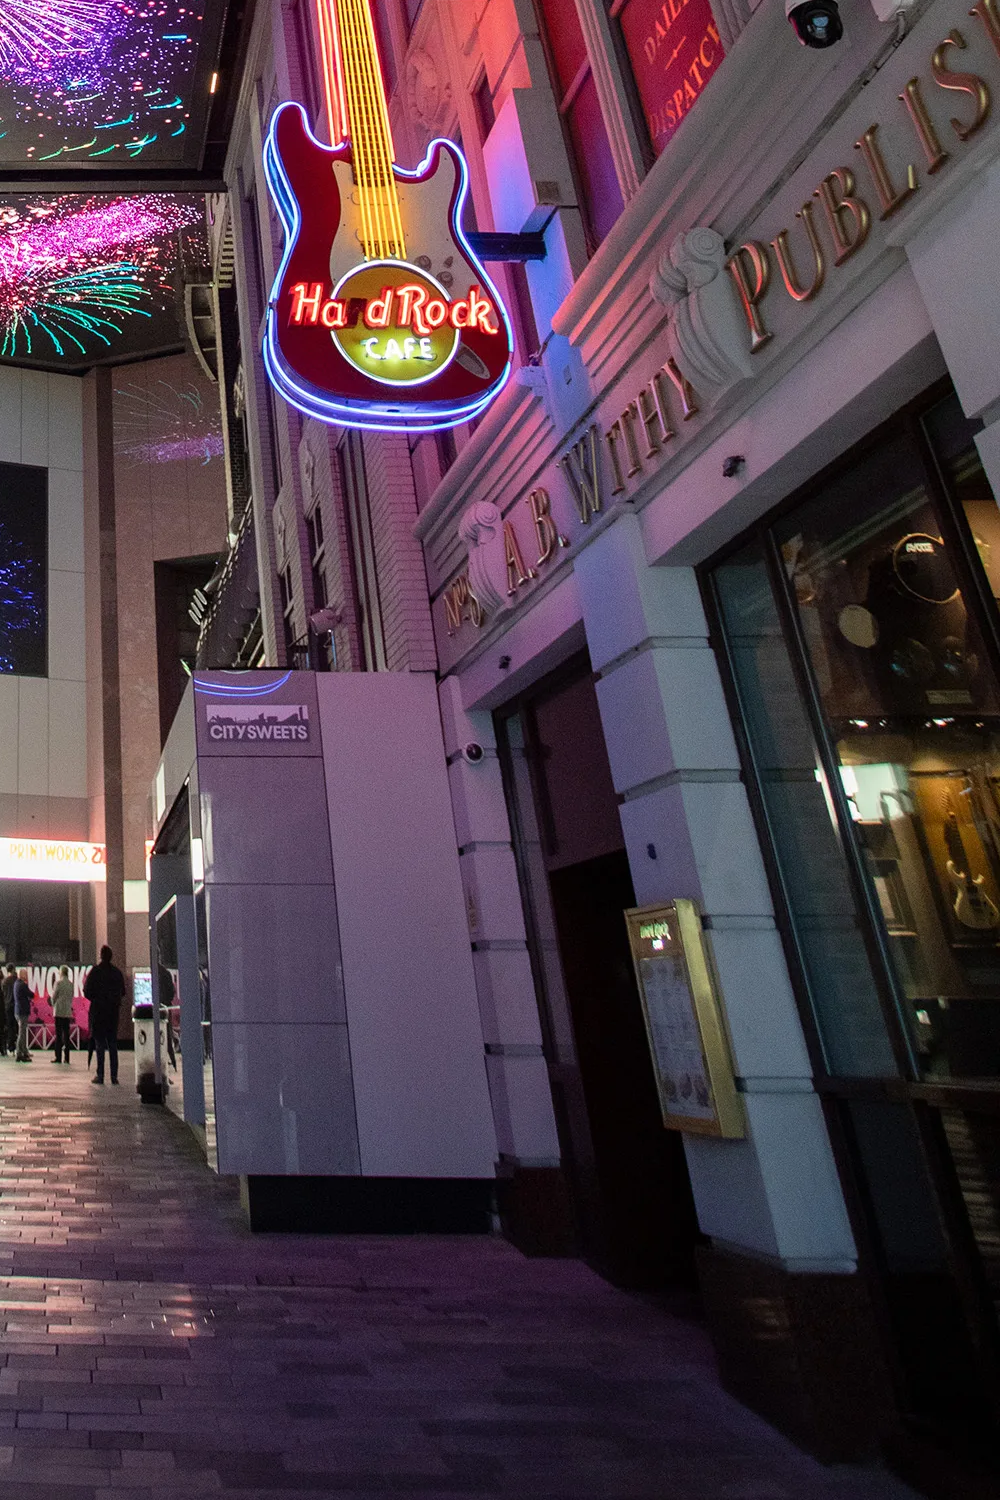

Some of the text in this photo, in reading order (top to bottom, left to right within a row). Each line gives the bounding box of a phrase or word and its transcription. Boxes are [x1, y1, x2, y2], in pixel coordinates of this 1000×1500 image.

[288, 282, 499, 336] Hard Rock
[360, 336, 437, 361] CAFE
[556, 356, 698, 525] WITHY
